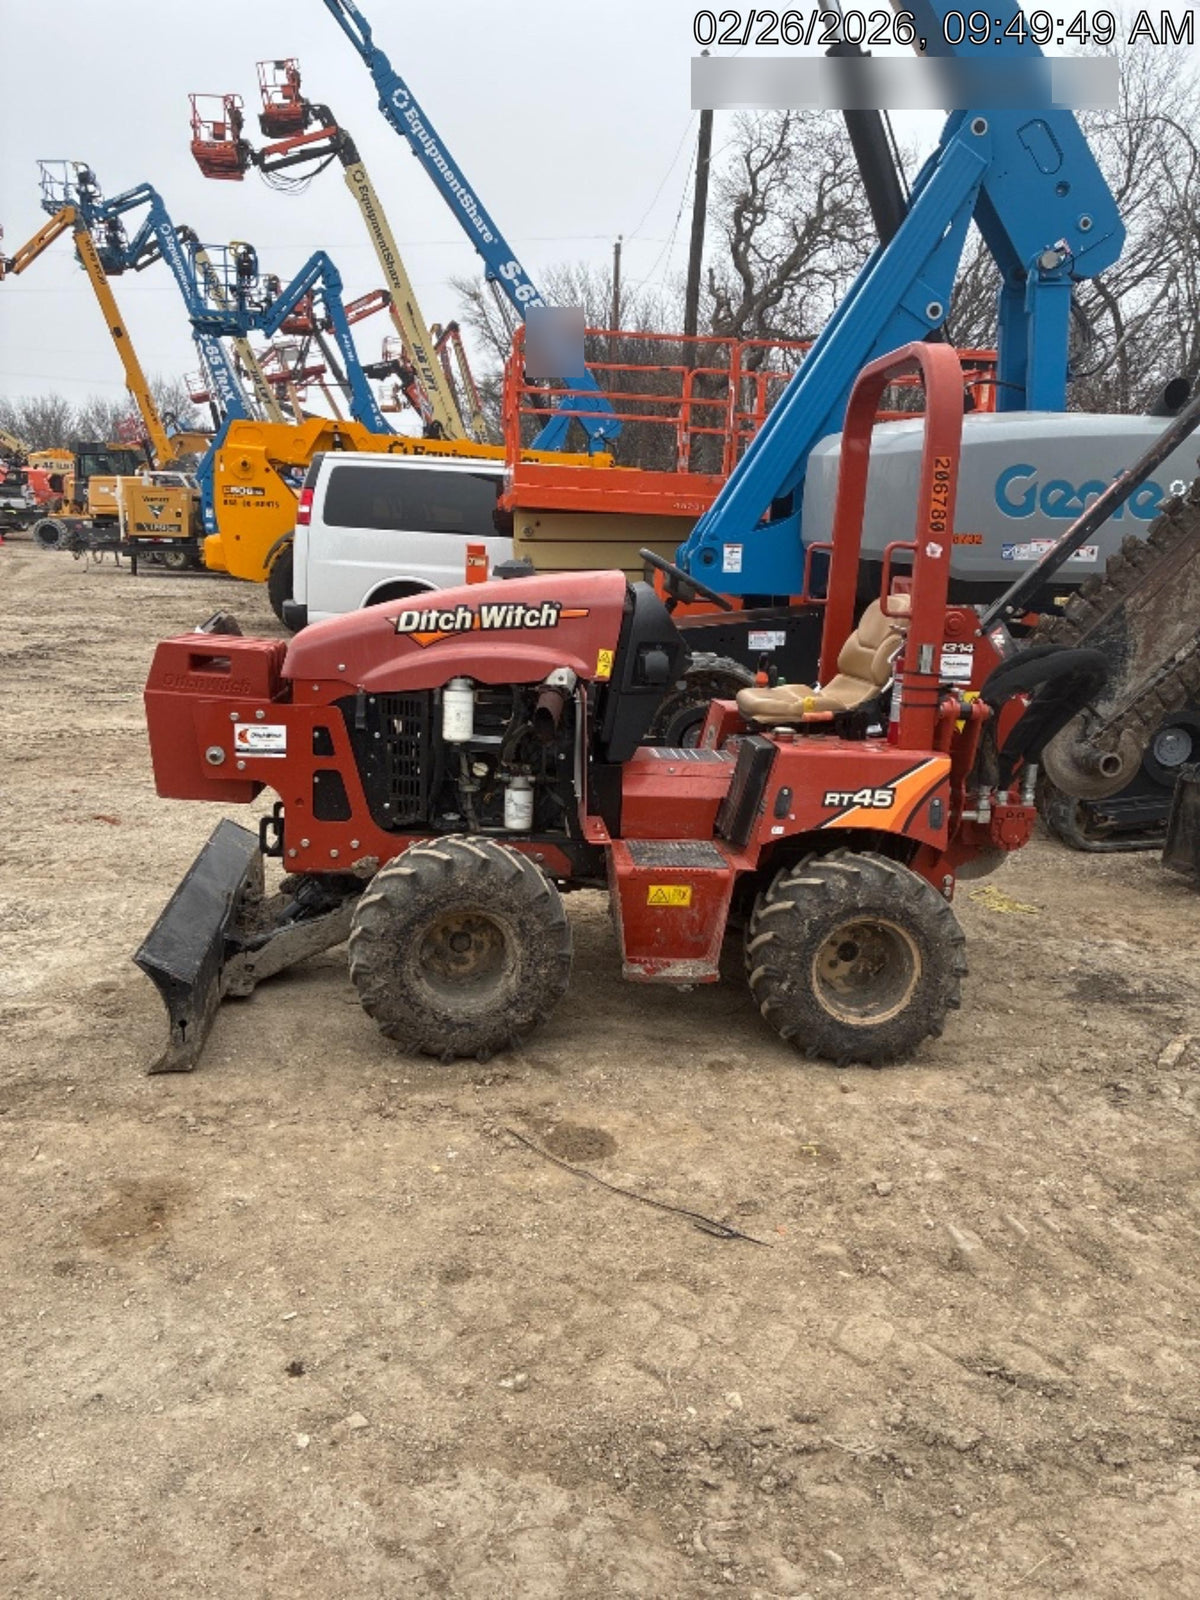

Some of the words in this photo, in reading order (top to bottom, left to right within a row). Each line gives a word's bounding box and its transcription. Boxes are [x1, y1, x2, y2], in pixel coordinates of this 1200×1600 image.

[403, 106, 494, 243] EquipmentShare
[929, 458, 951, 532] 206780
[397, 604, 473, 632] Ditch
[480, 602, 558, 629] Witch
[824, 789, 894, 807] RT45
